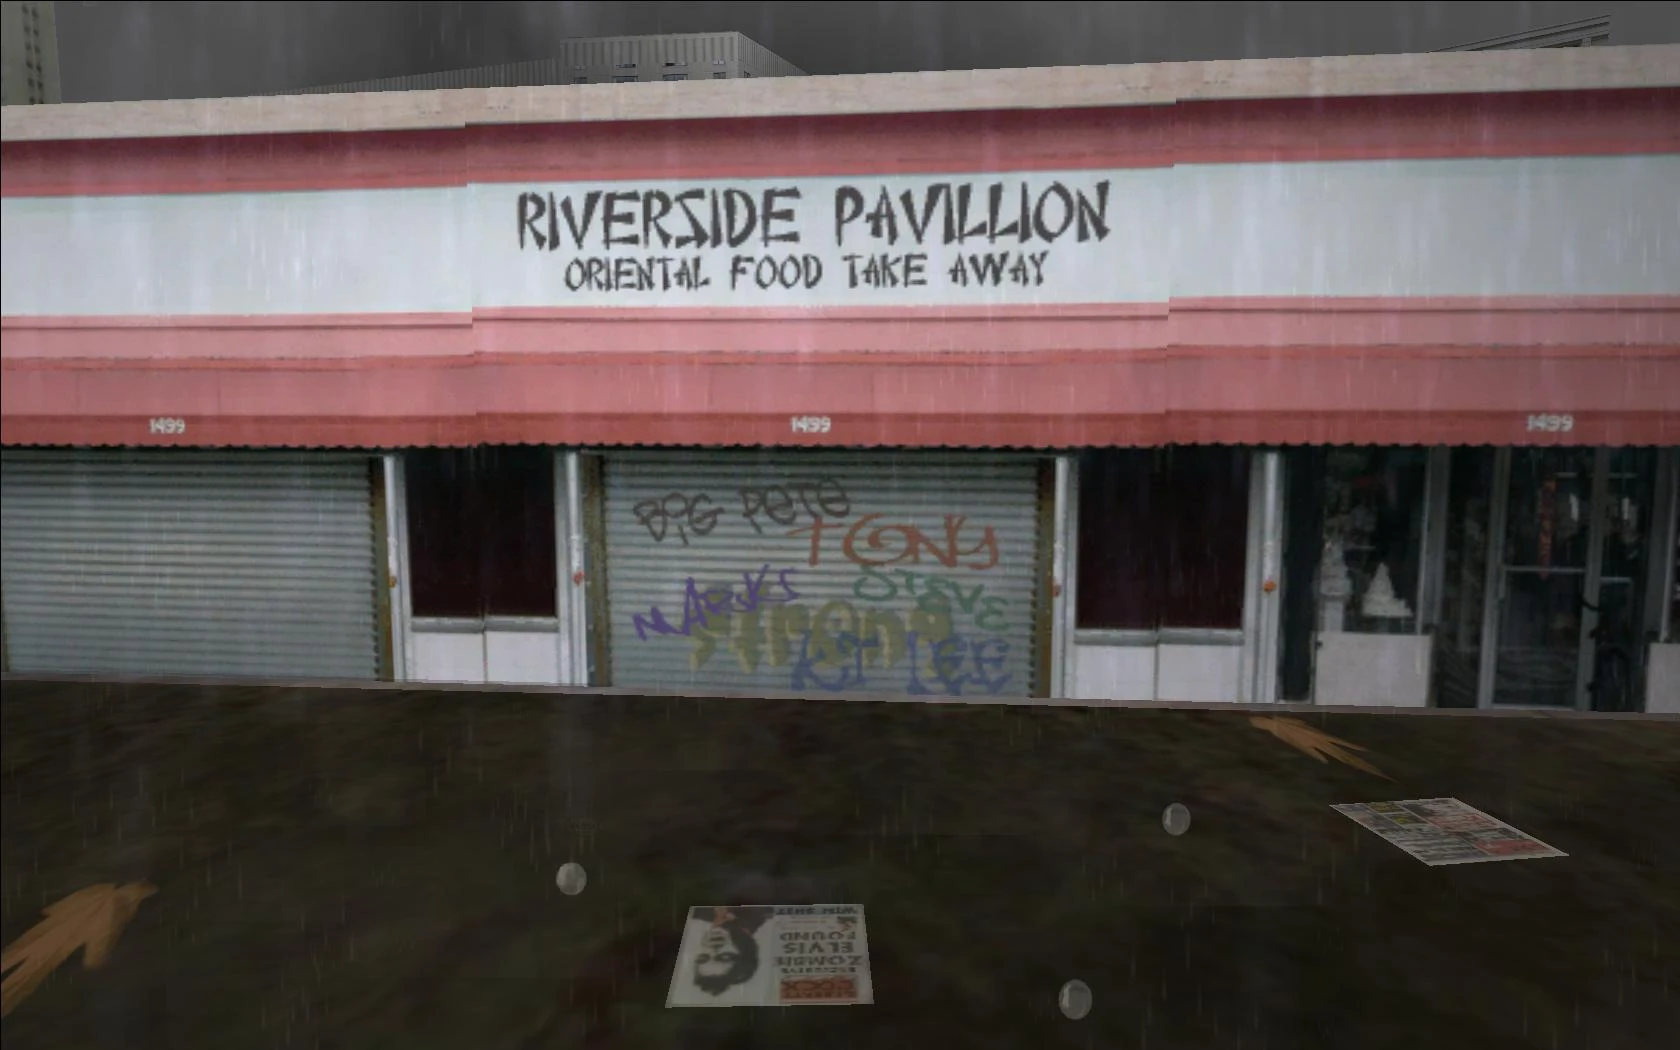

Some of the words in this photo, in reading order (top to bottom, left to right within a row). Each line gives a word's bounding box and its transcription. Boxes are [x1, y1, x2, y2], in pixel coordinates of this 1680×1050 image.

[517, 187, 802, 251] RIVERSIDE
[835, 179, 1111, 246] PAVILLION
[564, 254, 711, 292] ORIENTAL
[731, 252, 823, 290] FOOD
[842, 252, 929, 288] TAKE
[948, 250, 1050, 287] AWAY
[779, 930, 857, 941] FOUND
[782, 942, 855, 954] ELVIS
